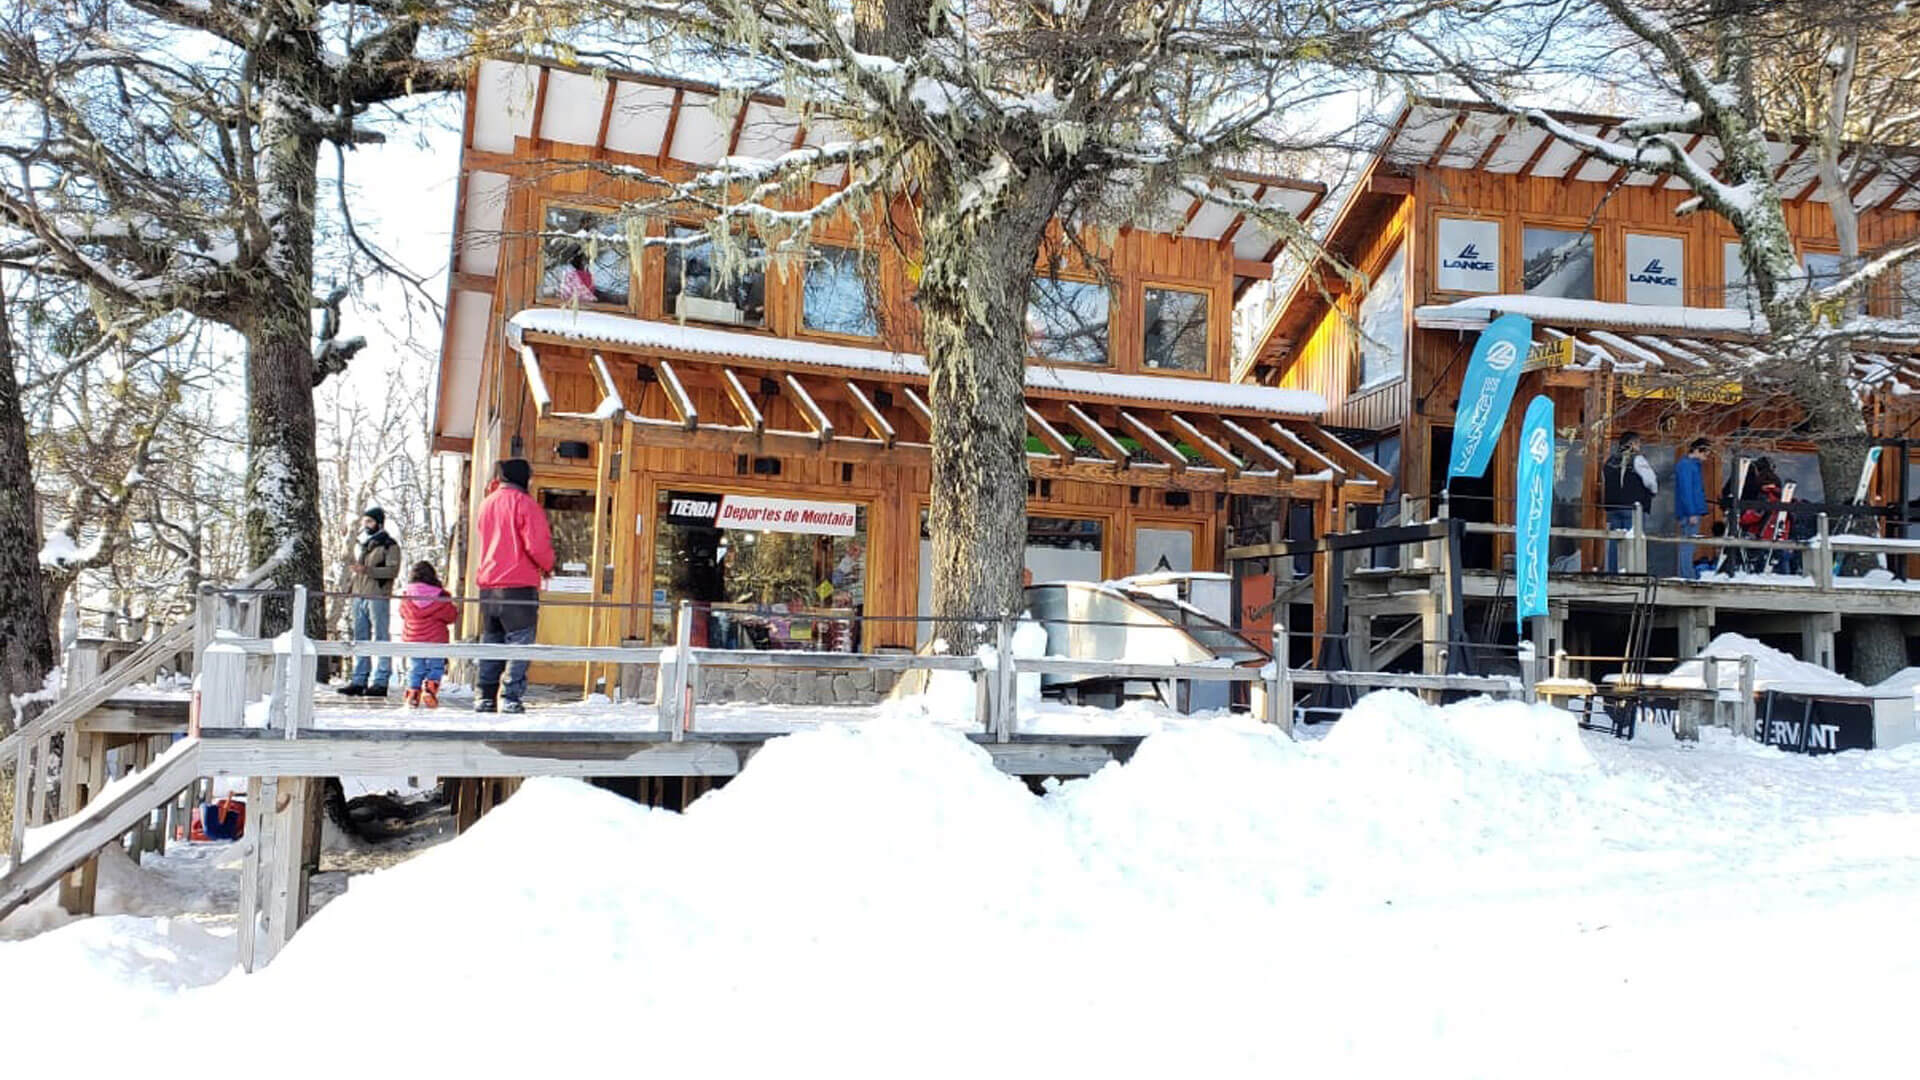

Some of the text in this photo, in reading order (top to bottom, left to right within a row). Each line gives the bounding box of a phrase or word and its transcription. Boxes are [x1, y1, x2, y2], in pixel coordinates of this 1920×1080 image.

[1443, 258, 1495, 272] LANGE
[1629, 273, 1677, 287] LANGE
[669, 499, 854, 527] TIENDA Deportes de Montaña
